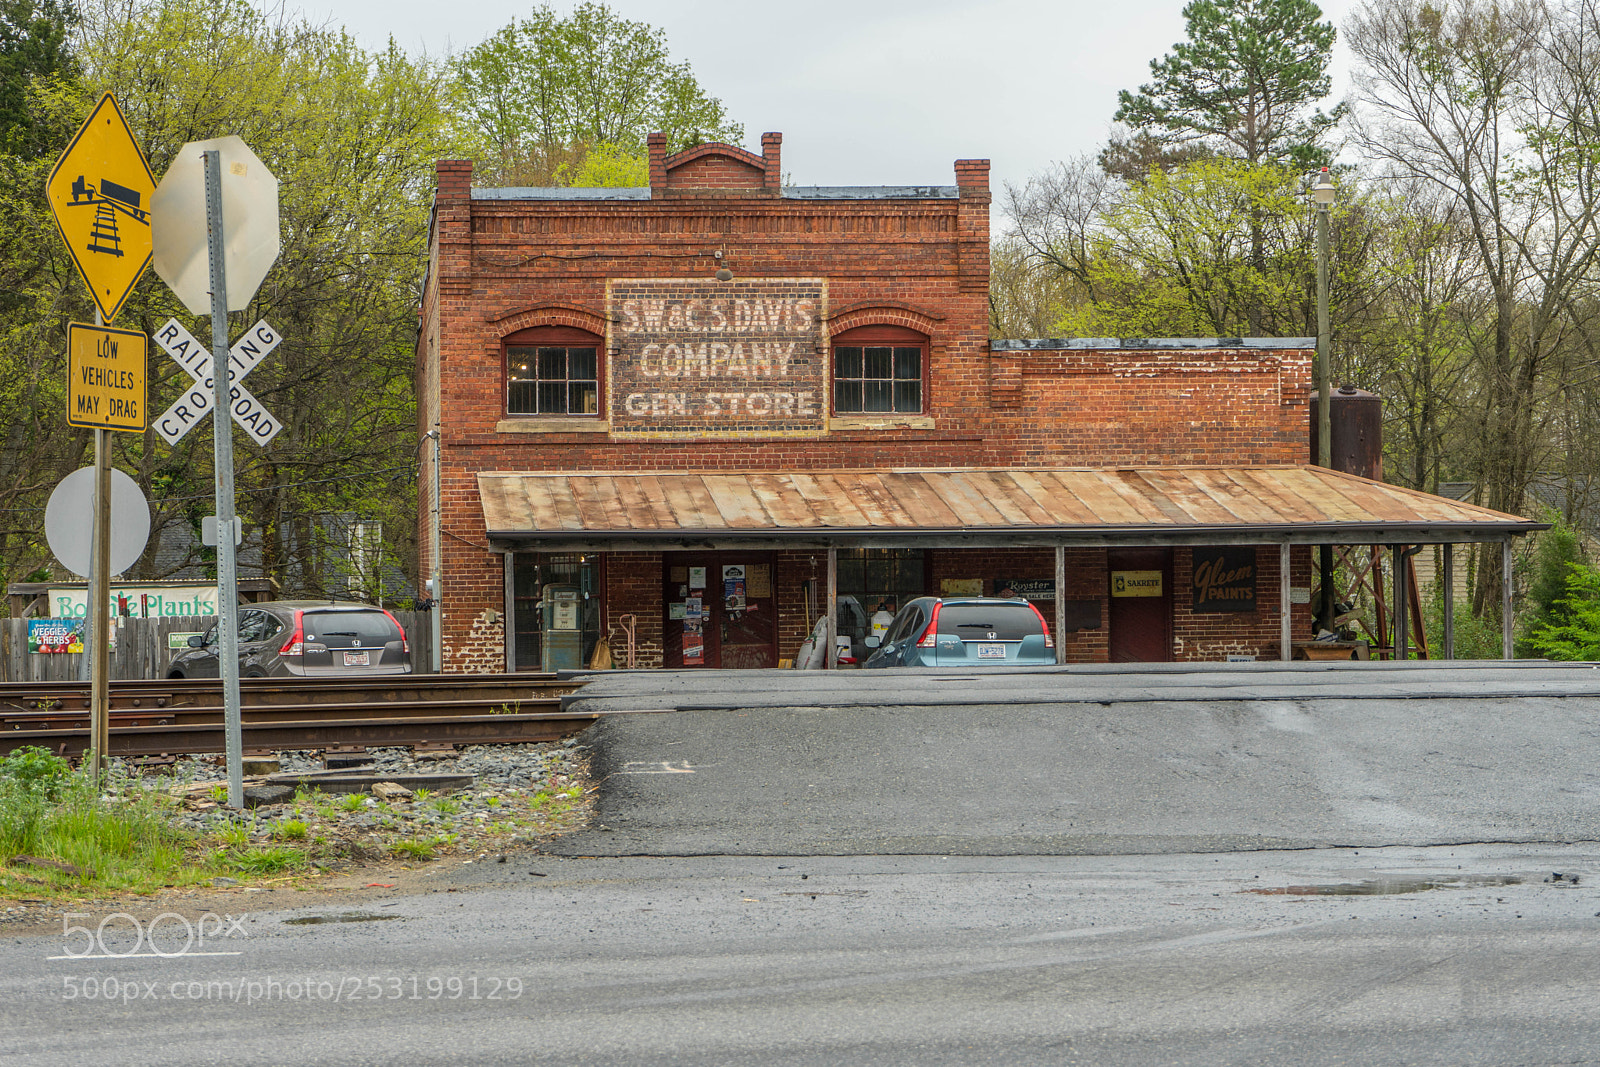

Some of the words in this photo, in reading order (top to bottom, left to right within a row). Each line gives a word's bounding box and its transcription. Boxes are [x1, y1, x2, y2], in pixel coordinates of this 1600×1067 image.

[735, 299, 812, 332] DAVIS
[97, 338, 119, 360] LOW
[641, 342, 796, 377] COMPANY
[82, 366, 134, 390] VEHICLES
[77, 394, 100, 415] MAY
[109, 398, 137, 419] DRAG
[704, 392, 814, 415] STORE
[1006, 580, 1050, 590] Royster
[1127, 579, 1160, 587] SAKRETE
[1208, 587, 1253, 599] PAINTS
[144, 594, 215, 617] Plants
[34, 627, 68, 637] VEGGIES
[44, 636, 70, 645] HERBS
